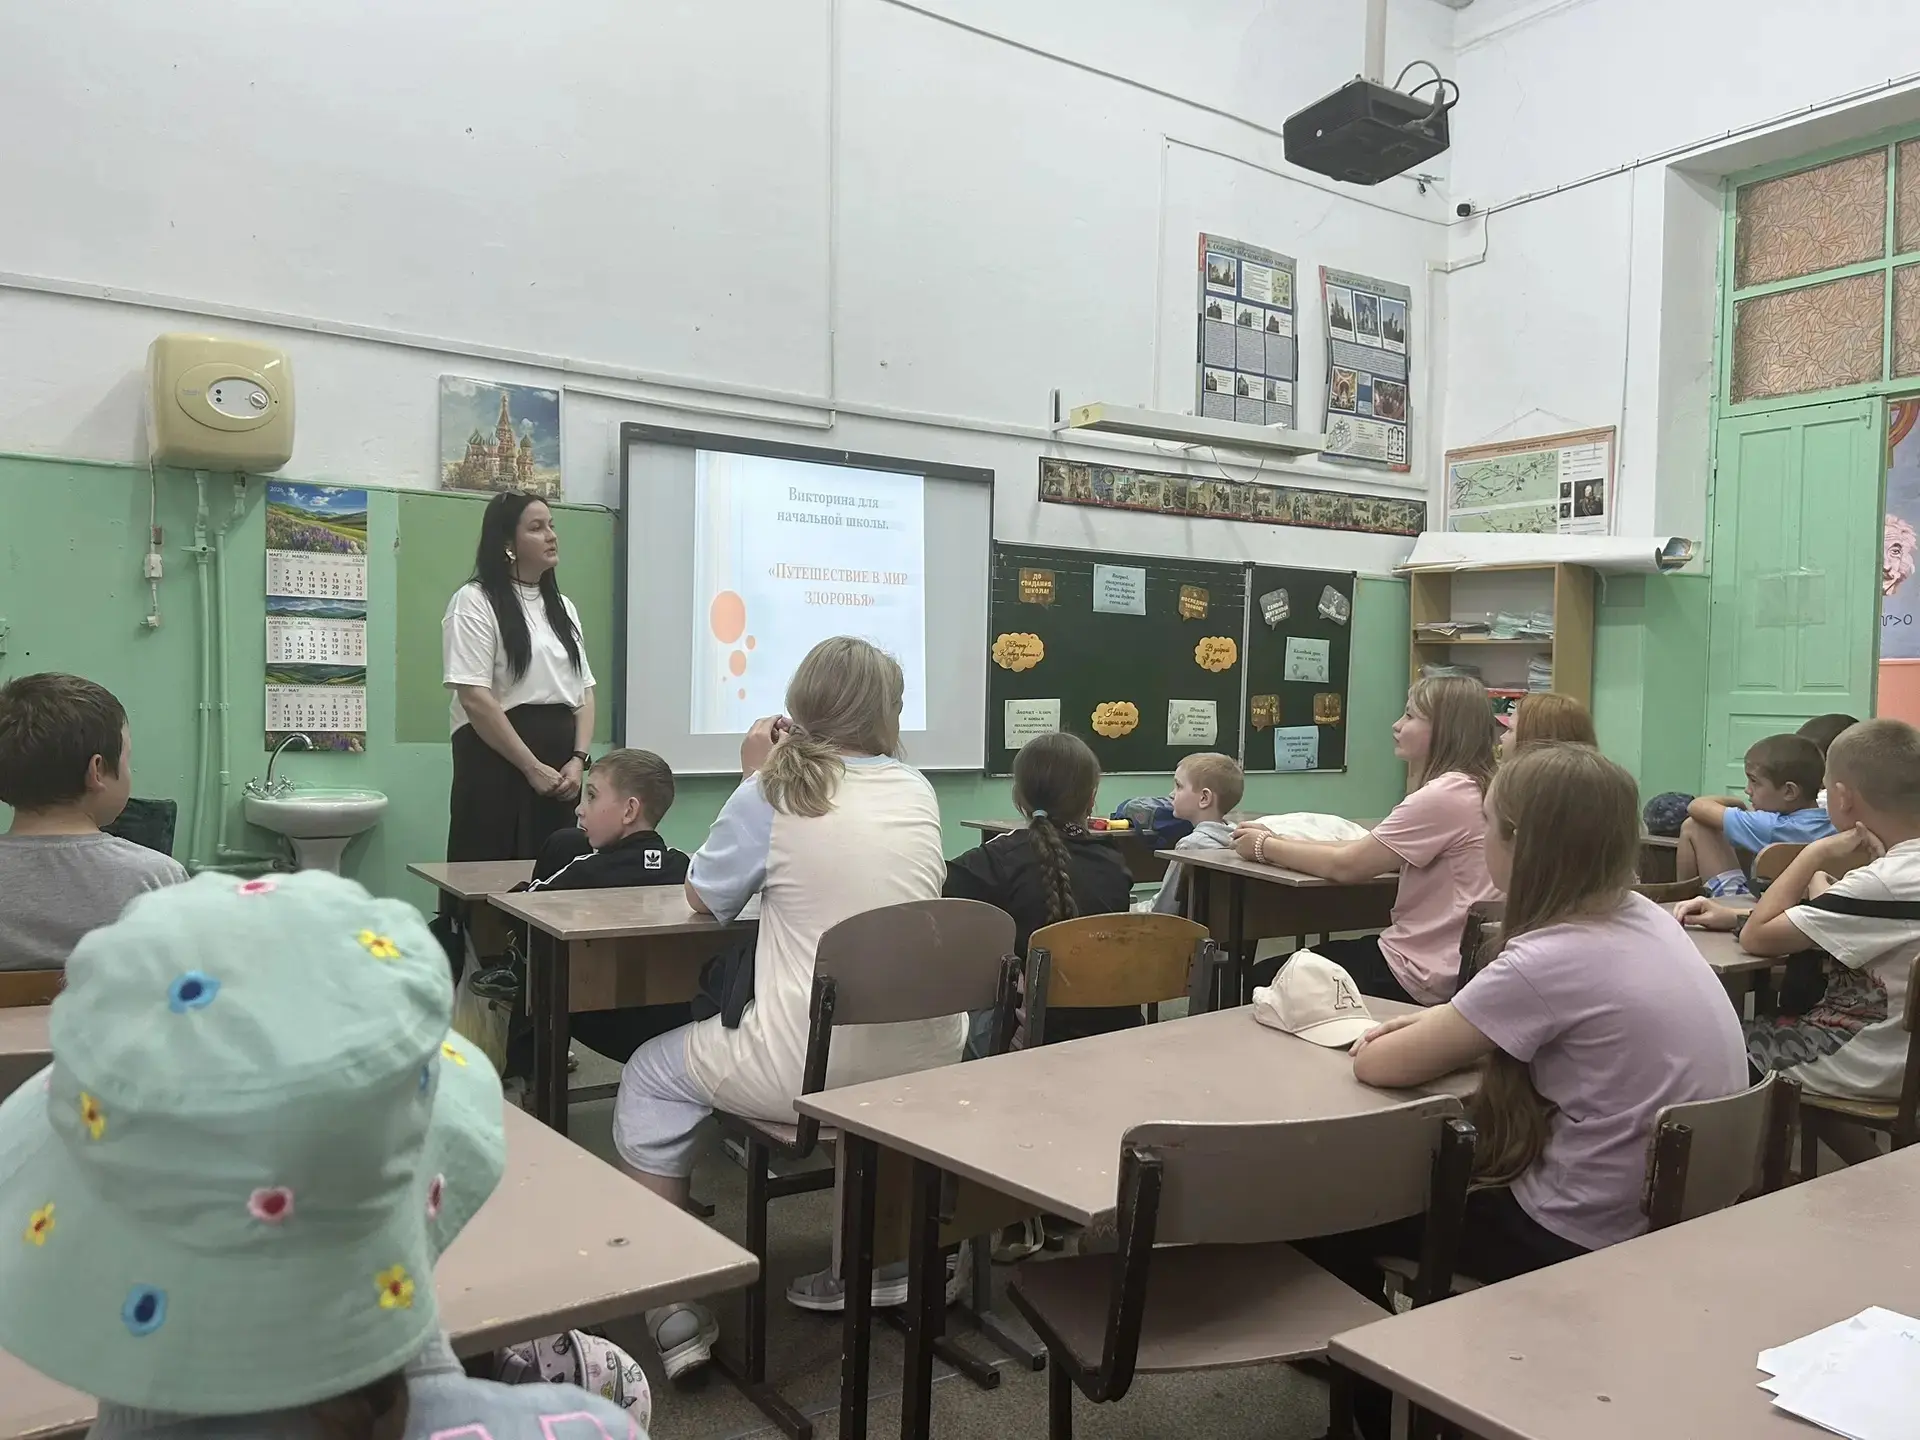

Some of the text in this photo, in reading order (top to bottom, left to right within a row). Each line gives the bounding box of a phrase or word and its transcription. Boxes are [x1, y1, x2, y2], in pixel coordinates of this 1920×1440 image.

[789, 486, 878, 508] Викторина для
[777, 511, 889, 529] начальной школы.
[883, 572, 908, 585] МИР
[805, 591, 874, 606] ЗДОРОВЬЯ»
[1332, 976, 1362, 1010] A
